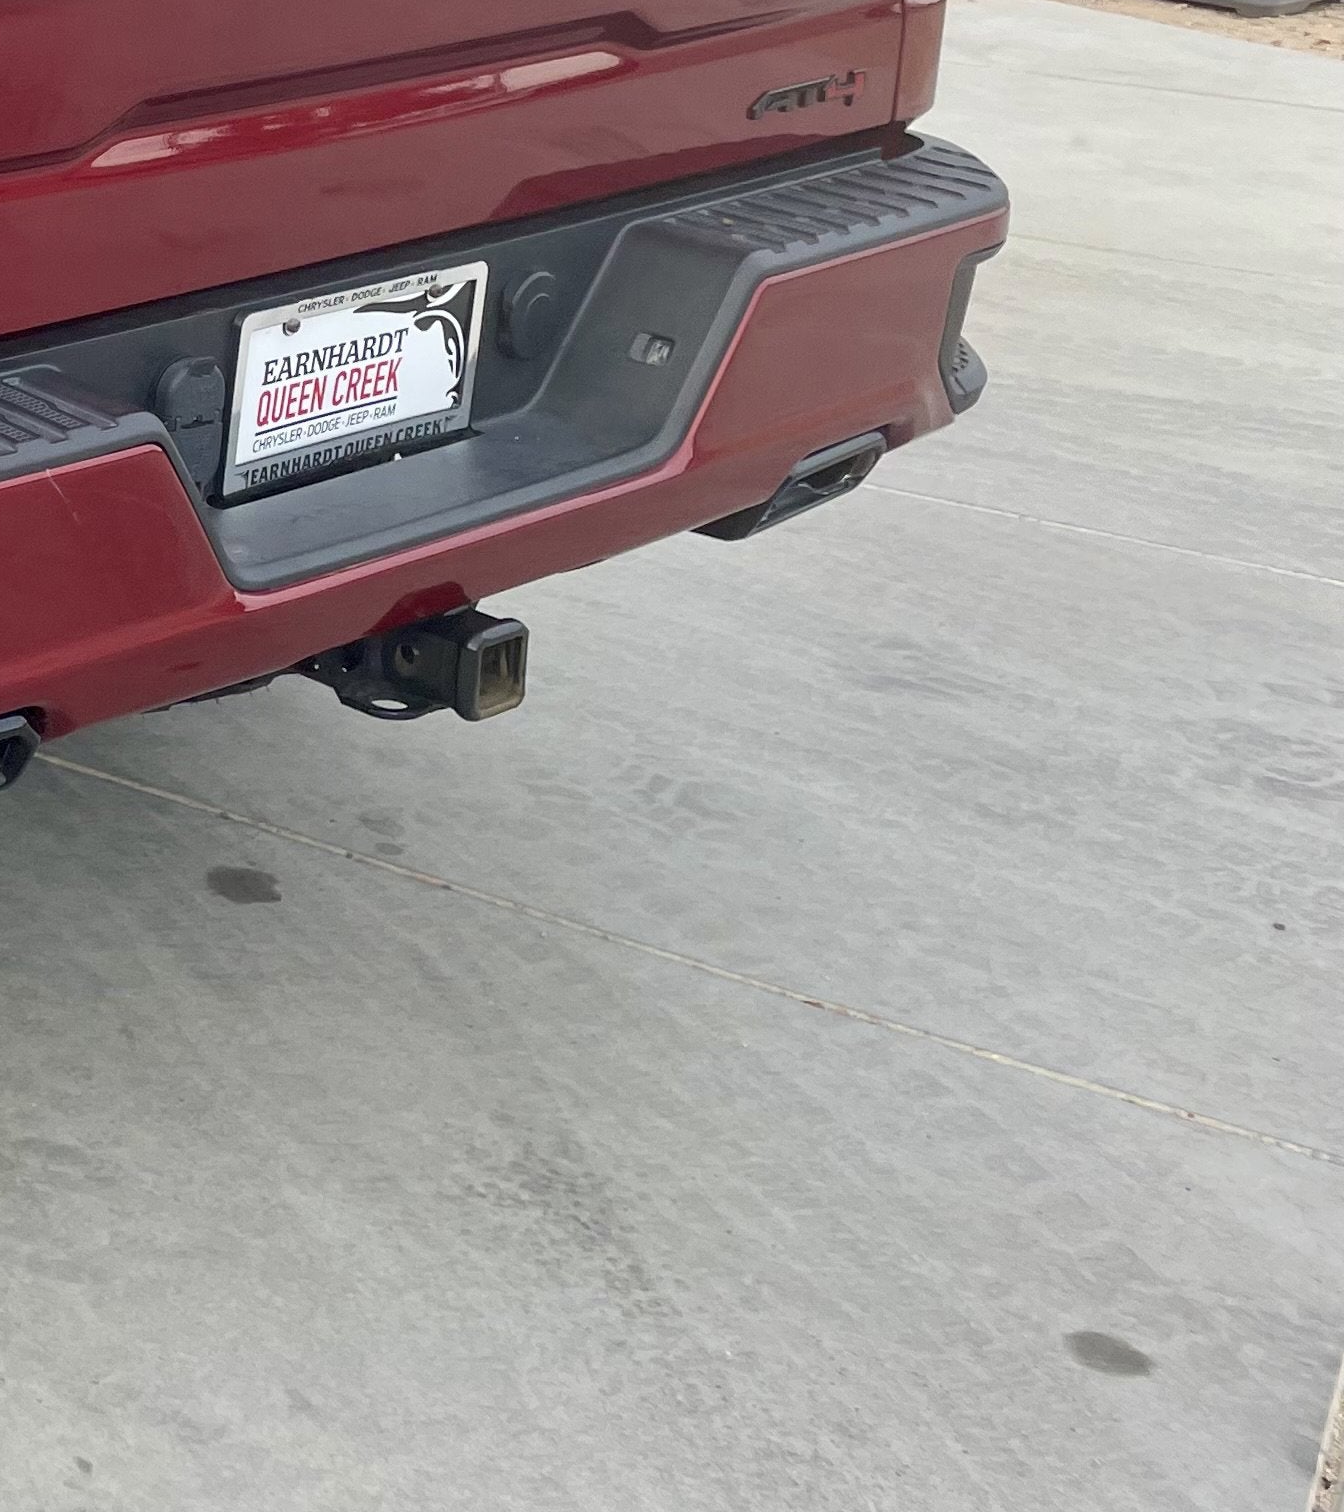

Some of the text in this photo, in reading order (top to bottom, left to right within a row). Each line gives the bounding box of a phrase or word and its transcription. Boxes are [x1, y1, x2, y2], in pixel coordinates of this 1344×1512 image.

[298, 274, 438, 314] CHRYSLER DODGE JEEP RAM
[262, 328, 410, 386] EARNHARDT
[256, 357, 403, 427] QUEEN CREEK
[250, 447, 341, 486] EARNHARDT
[396, 418, 441, 444] CREEK
[252, 404, 397, 453] CHRYSLER DODGE JEEP RAM
